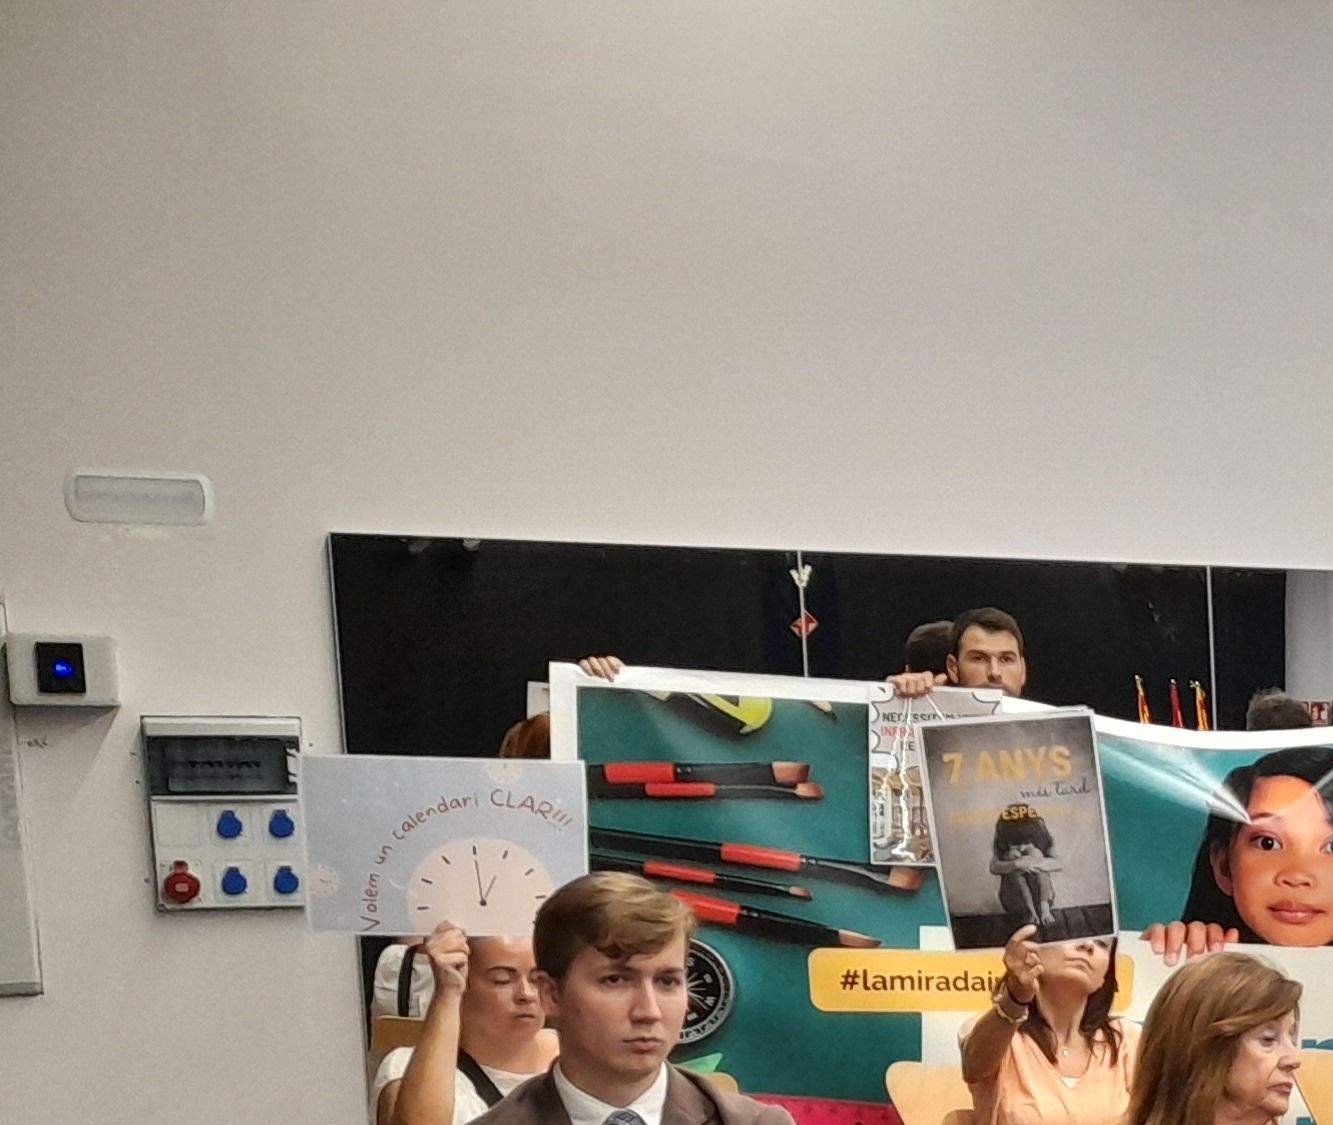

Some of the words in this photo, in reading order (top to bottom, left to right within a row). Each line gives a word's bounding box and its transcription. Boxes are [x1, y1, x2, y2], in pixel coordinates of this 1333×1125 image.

[942, 752, 964, 784] 7
[977, 745, 1072, 781] ANYS
[359, 871, 381, 931] Volem
[375, 844, 392, 865] un
[392, 795, 479, 840] calendari
